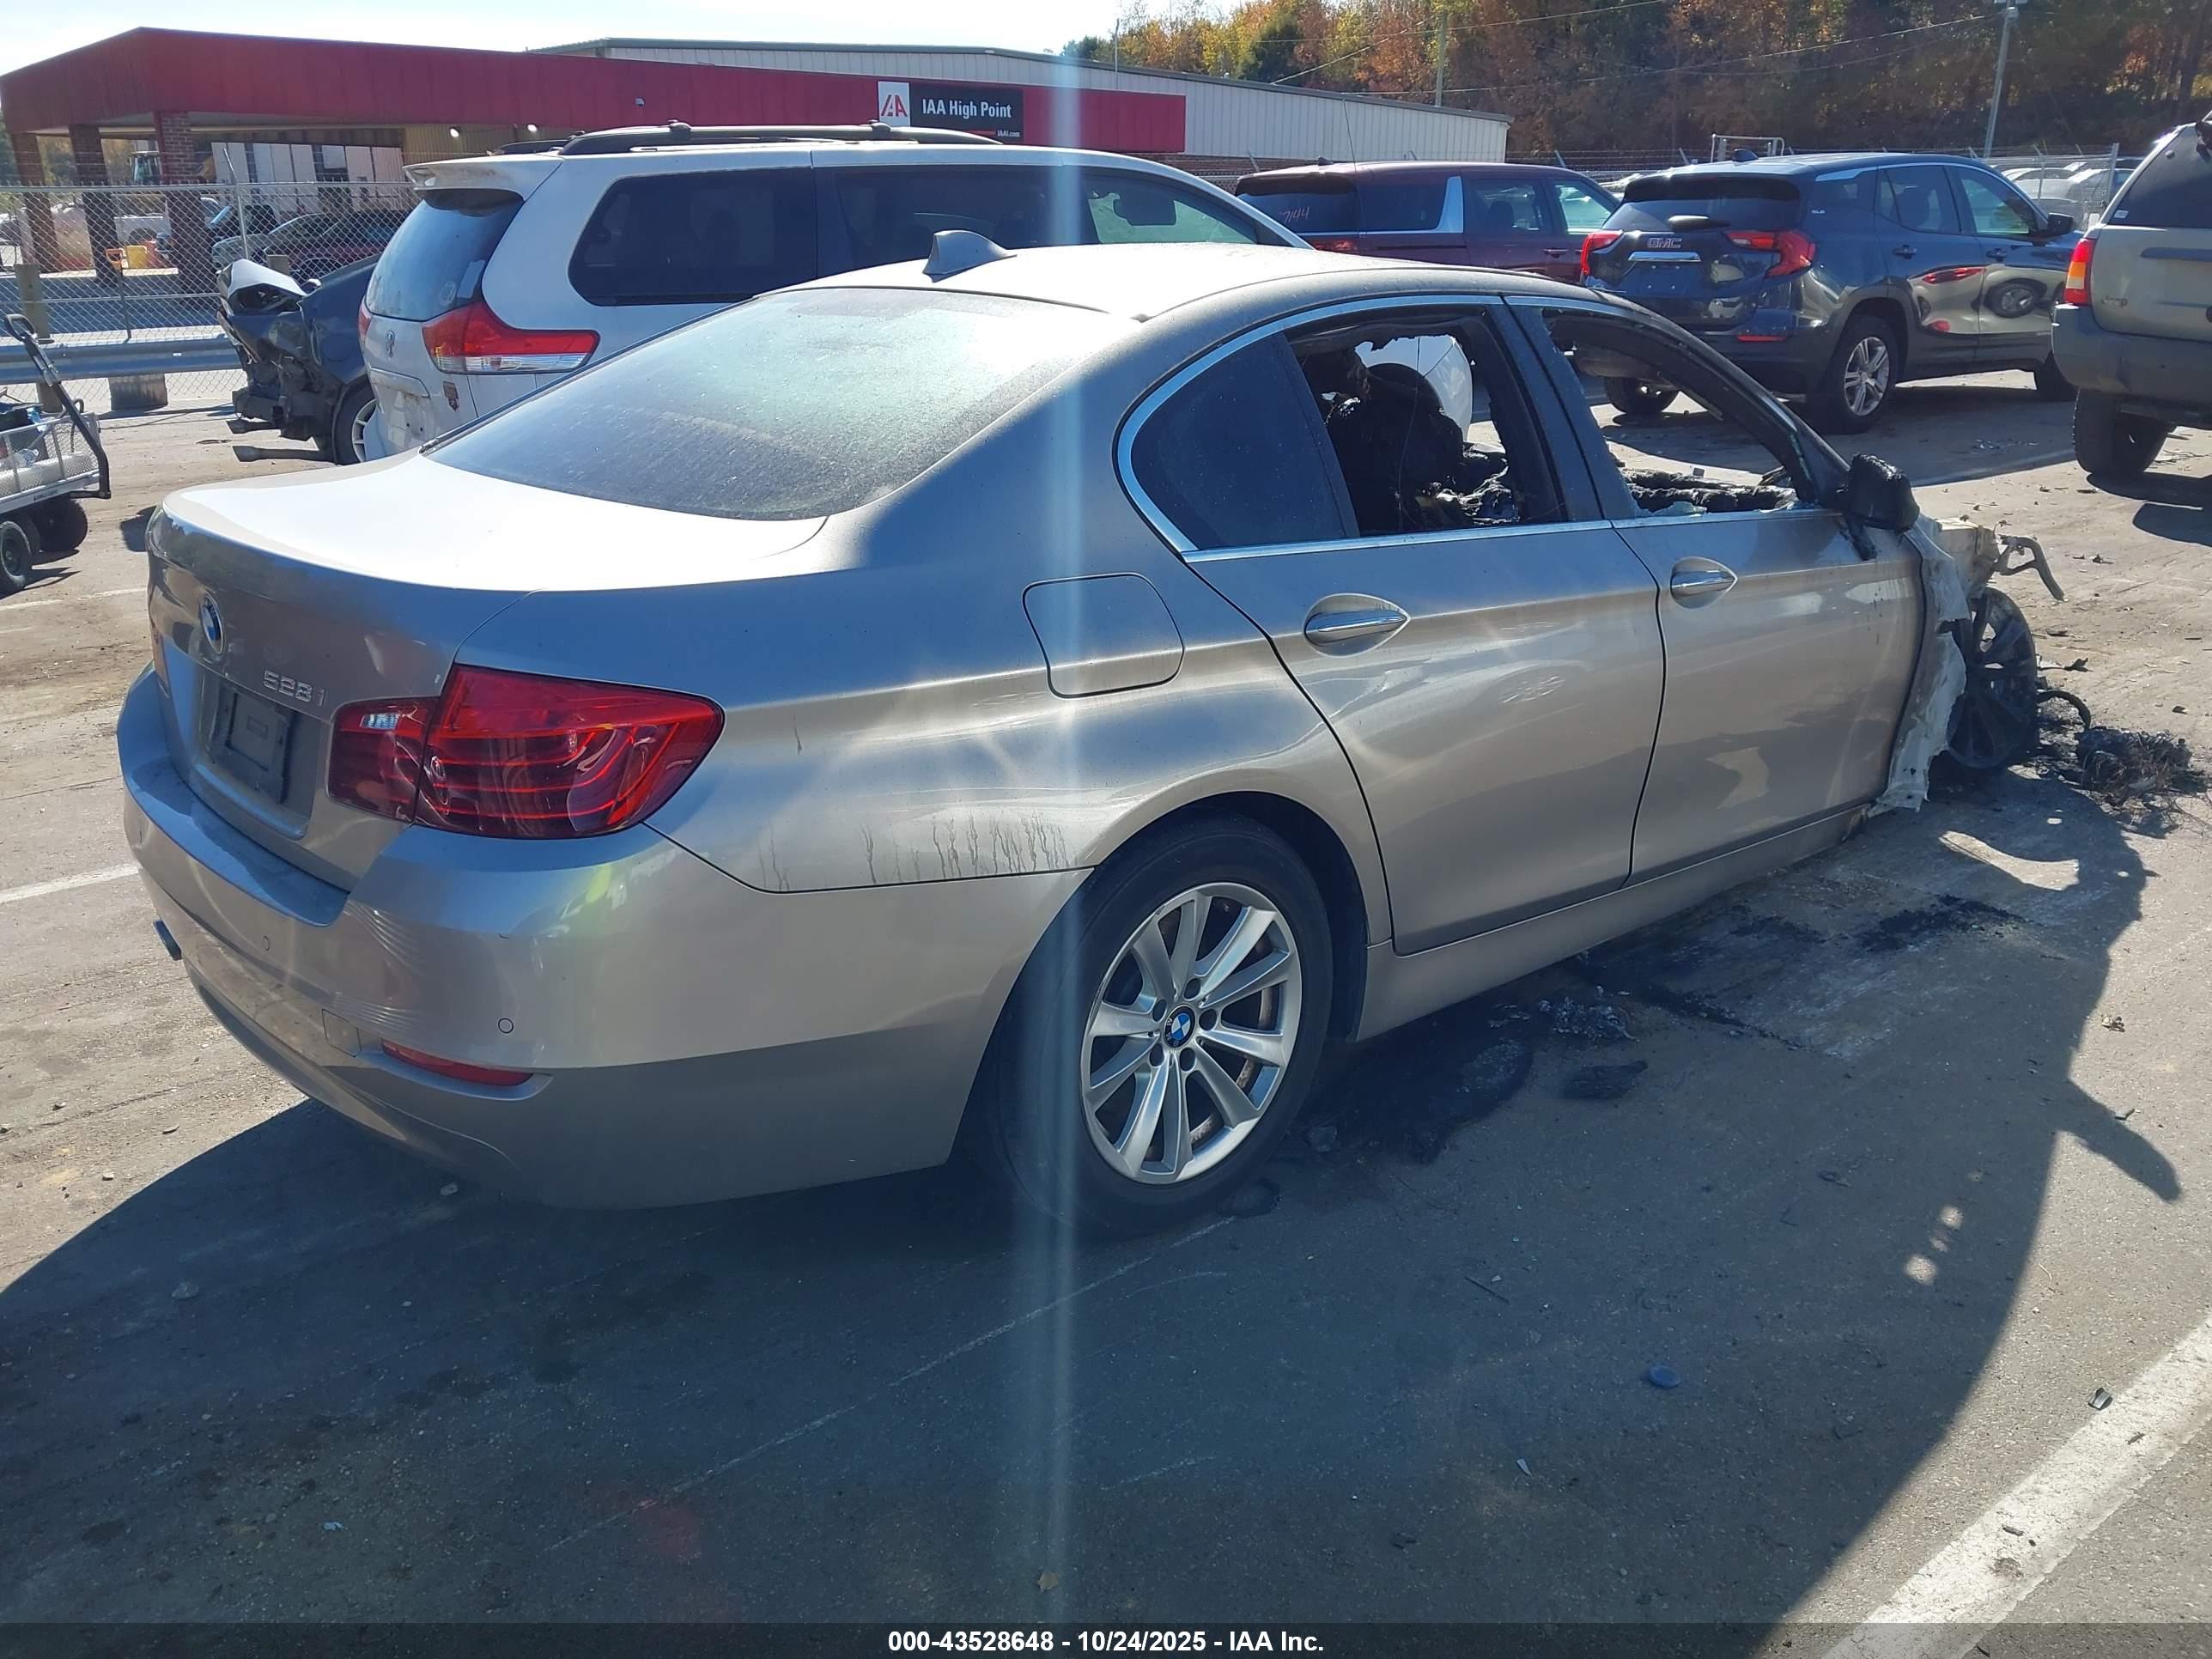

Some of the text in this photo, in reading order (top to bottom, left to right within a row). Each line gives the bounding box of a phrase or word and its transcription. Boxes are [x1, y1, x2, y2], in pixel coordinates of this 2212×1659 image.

[922, 99, 1012, 119] IAA High Point
[1647, 237, 1682, 248] GMC
